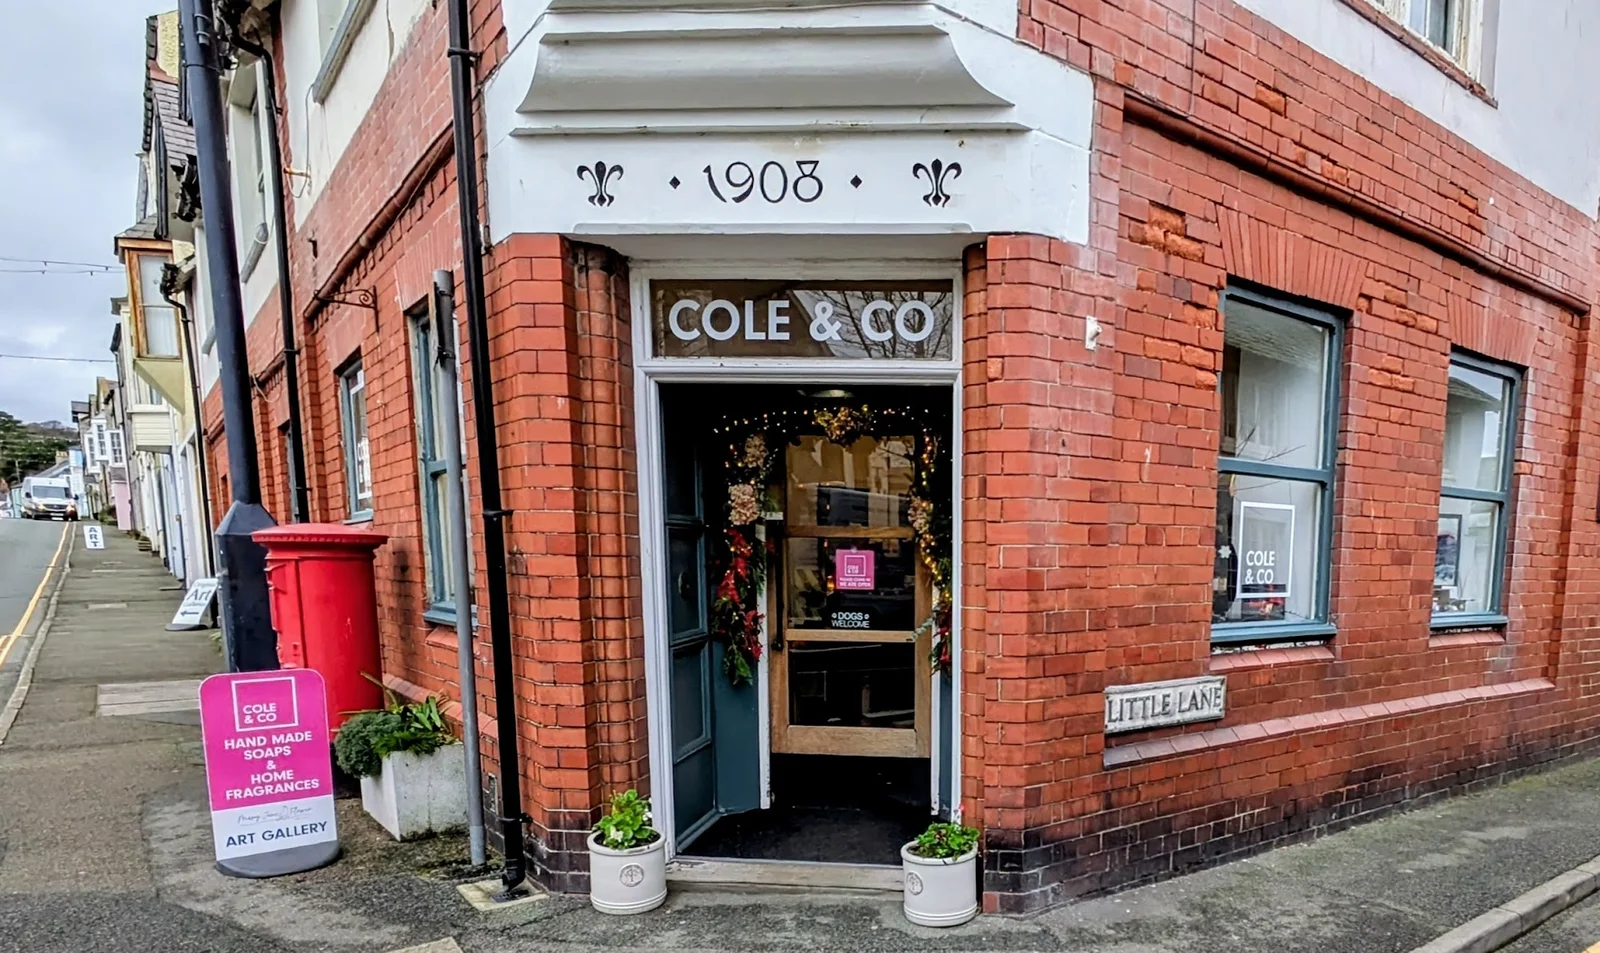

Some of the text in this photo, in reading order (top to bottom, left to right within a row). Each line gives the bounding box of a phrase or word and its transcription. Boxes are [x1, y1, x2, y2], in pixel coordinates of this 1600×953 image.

[703, 160, 823, 203] 1908
[668, 299, 934, 342] COLE & CO
[88, 526, 99, 547] ART
[1246, 550, 1275, 567] COLE
[1245, 568, 1274, 585] & CO
[186, 588, 211, 601] Art
[831, 619, 870, 628] WELCOME
[837, 611, 863, 620] DOGS
[243, 703, 277, 714] COLE
[1107, 687, 1222, 723] LITTLE LANE
[244, 712, 277, 724] & CO
[224, 731, 312, 750] HAND MADE
[243, 745, 291, 760] SOAPS
[266, 760, 276, 770] &
[250, 770, 294, 784] HOME
[225, 778, 320, 801] FRAGRANCES
[225, 820, 328, 848] ART GALLERY
